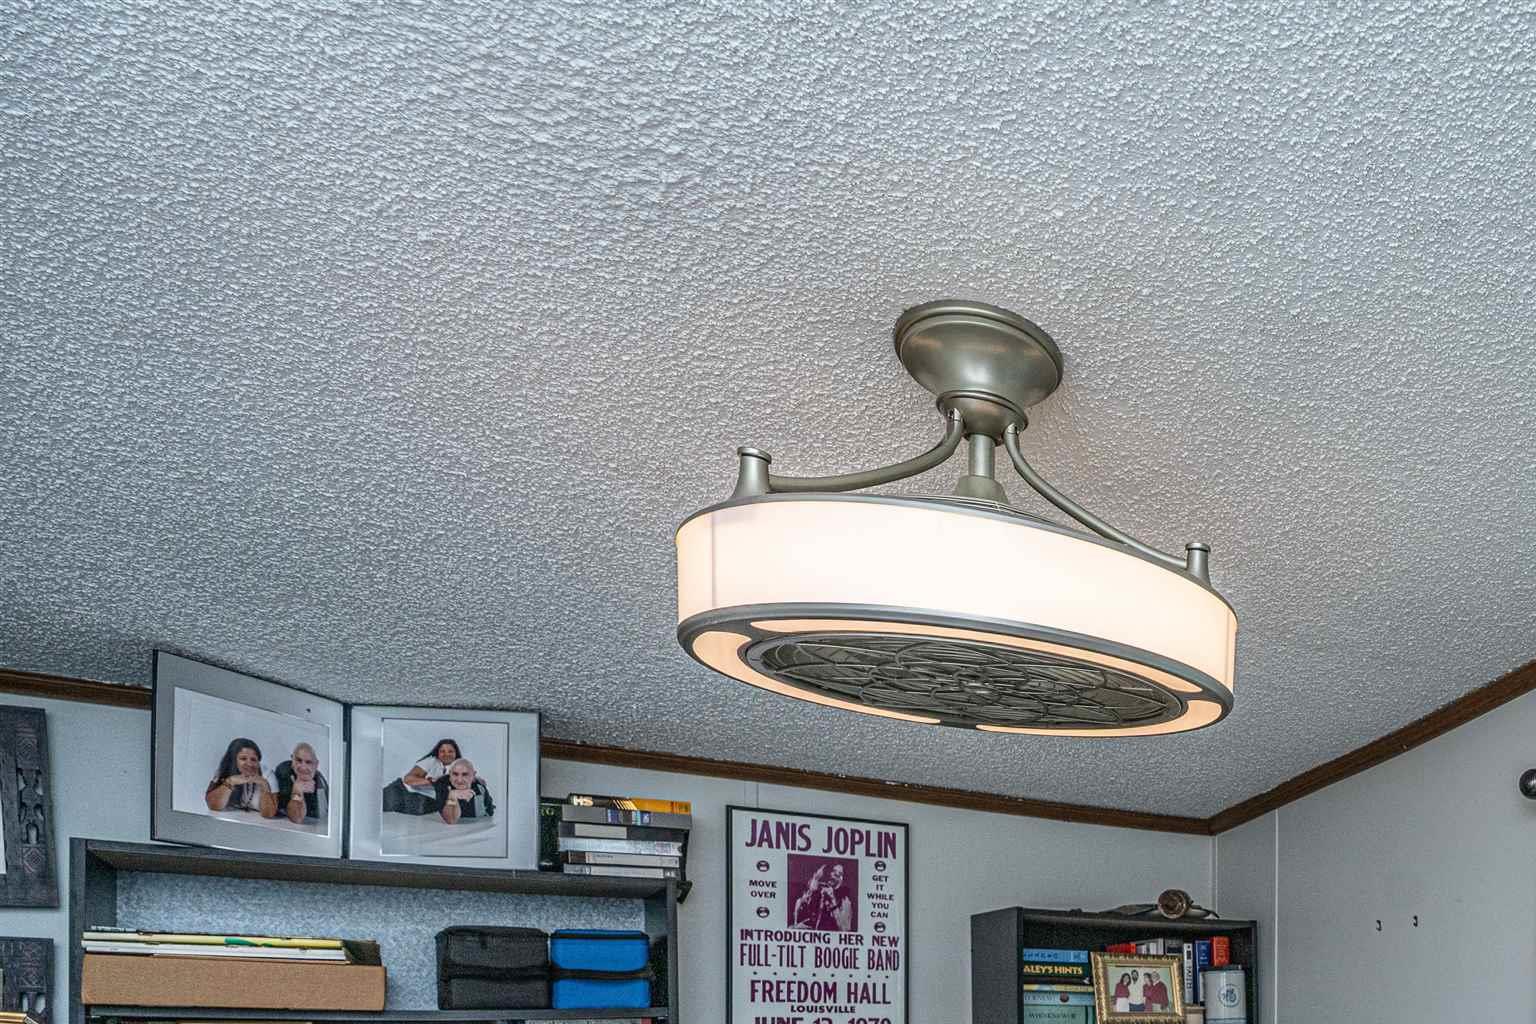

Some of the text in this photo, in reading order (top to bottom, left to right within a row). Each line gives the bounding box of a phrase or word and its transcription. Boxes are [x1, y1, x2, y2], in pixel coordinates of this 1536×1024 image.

[745, 819, 897, 859] JANIS JOPLIN
[872, 875, 888, 883] GET
[749, 879, 777, 889] MOVE
[750, 890, 776, 900] OVER
[867, 893, 894, 901] WHILE
[871, 902, 889, 910] YOU
[870, 911, 888, 919] CAN
[740, 928, 899, 948] INTRODUCING HER NEW
[740, 944, 900, 971] FULL-TILT BOOGIE BAND
[1054, 966, 1083, 975] HINTS
[750, 980, 892, 1005] FREEDOM HALL
[790, 1005, 856, 1014] LOUISVILLE
